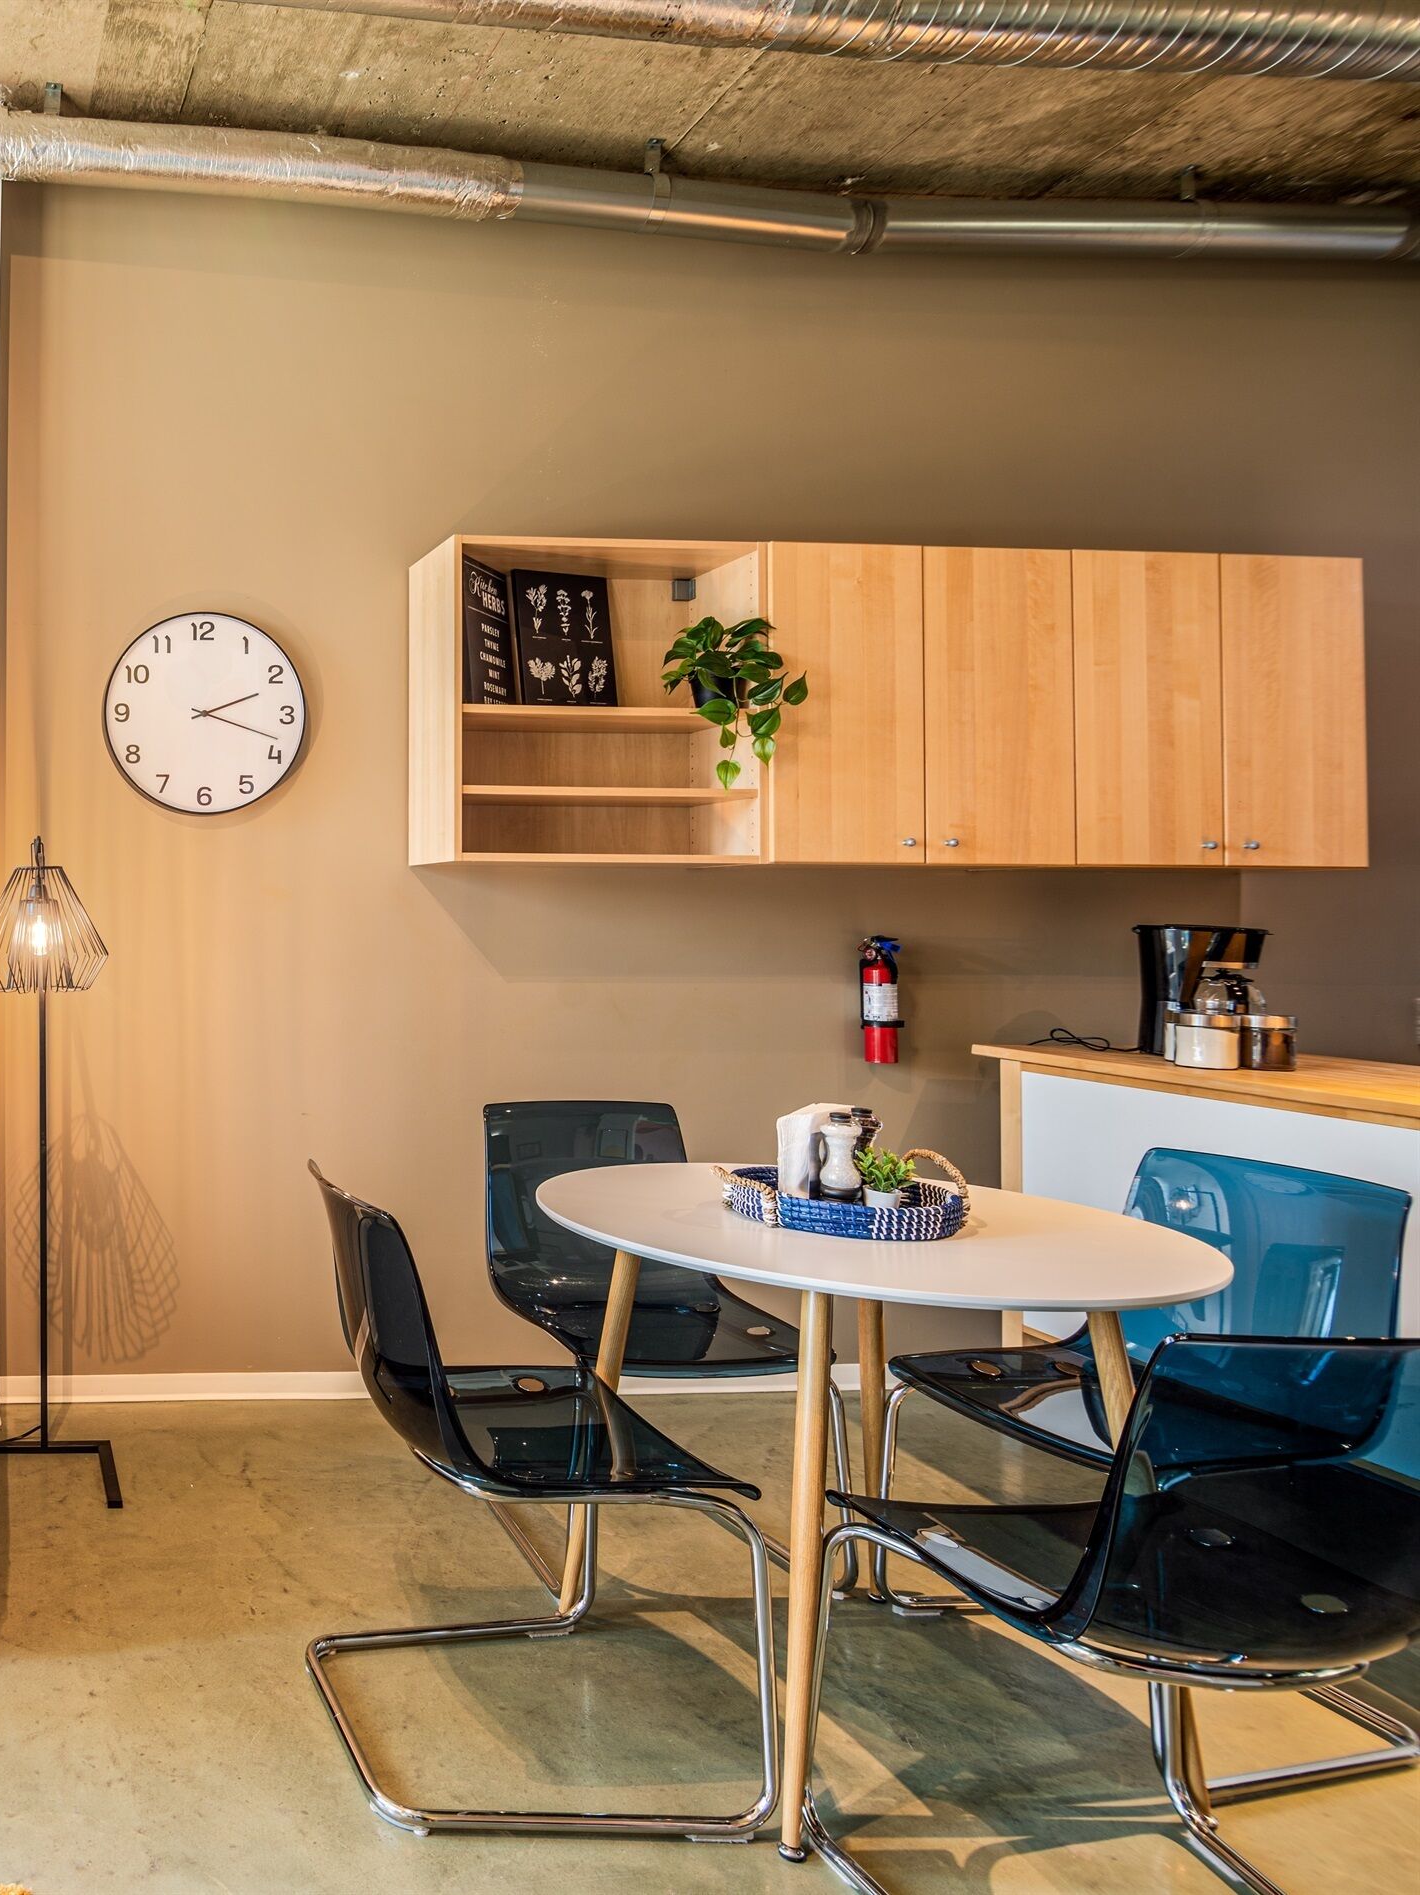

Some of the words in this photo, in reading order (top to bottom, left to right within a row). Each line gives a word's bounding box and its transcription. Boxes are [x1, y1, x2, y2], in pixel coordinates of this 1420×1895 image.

[469, 571, 498, 597] Kitchen
[482, 591, 505, 616] HERBS
[190, 621, 215, 641] 12
[481, 622, 500, 638] PARSLEY
[152, 634, 172, 654] 11
[242, 636, 249, 654] 1
[484, 638, 499, 652] THYME
[480, 651, 506, 669] CHAMOMILE
[125, 664, 150, 684] 10
[267, 664, 284, 684] 2
[488, 669, 500, 680] MINT
[484, 681, 507, 696] ROSEMARY
[114, 703, 130, 723] 9
[279, 705, 295, 725] 3
[125, 744, 141, 764] 8
[267, 745, 282, 764] 4
[155, 774, 170, 794] 7
[238, 775, 255, 795] 5
[196, 786, 213, 806] 6
